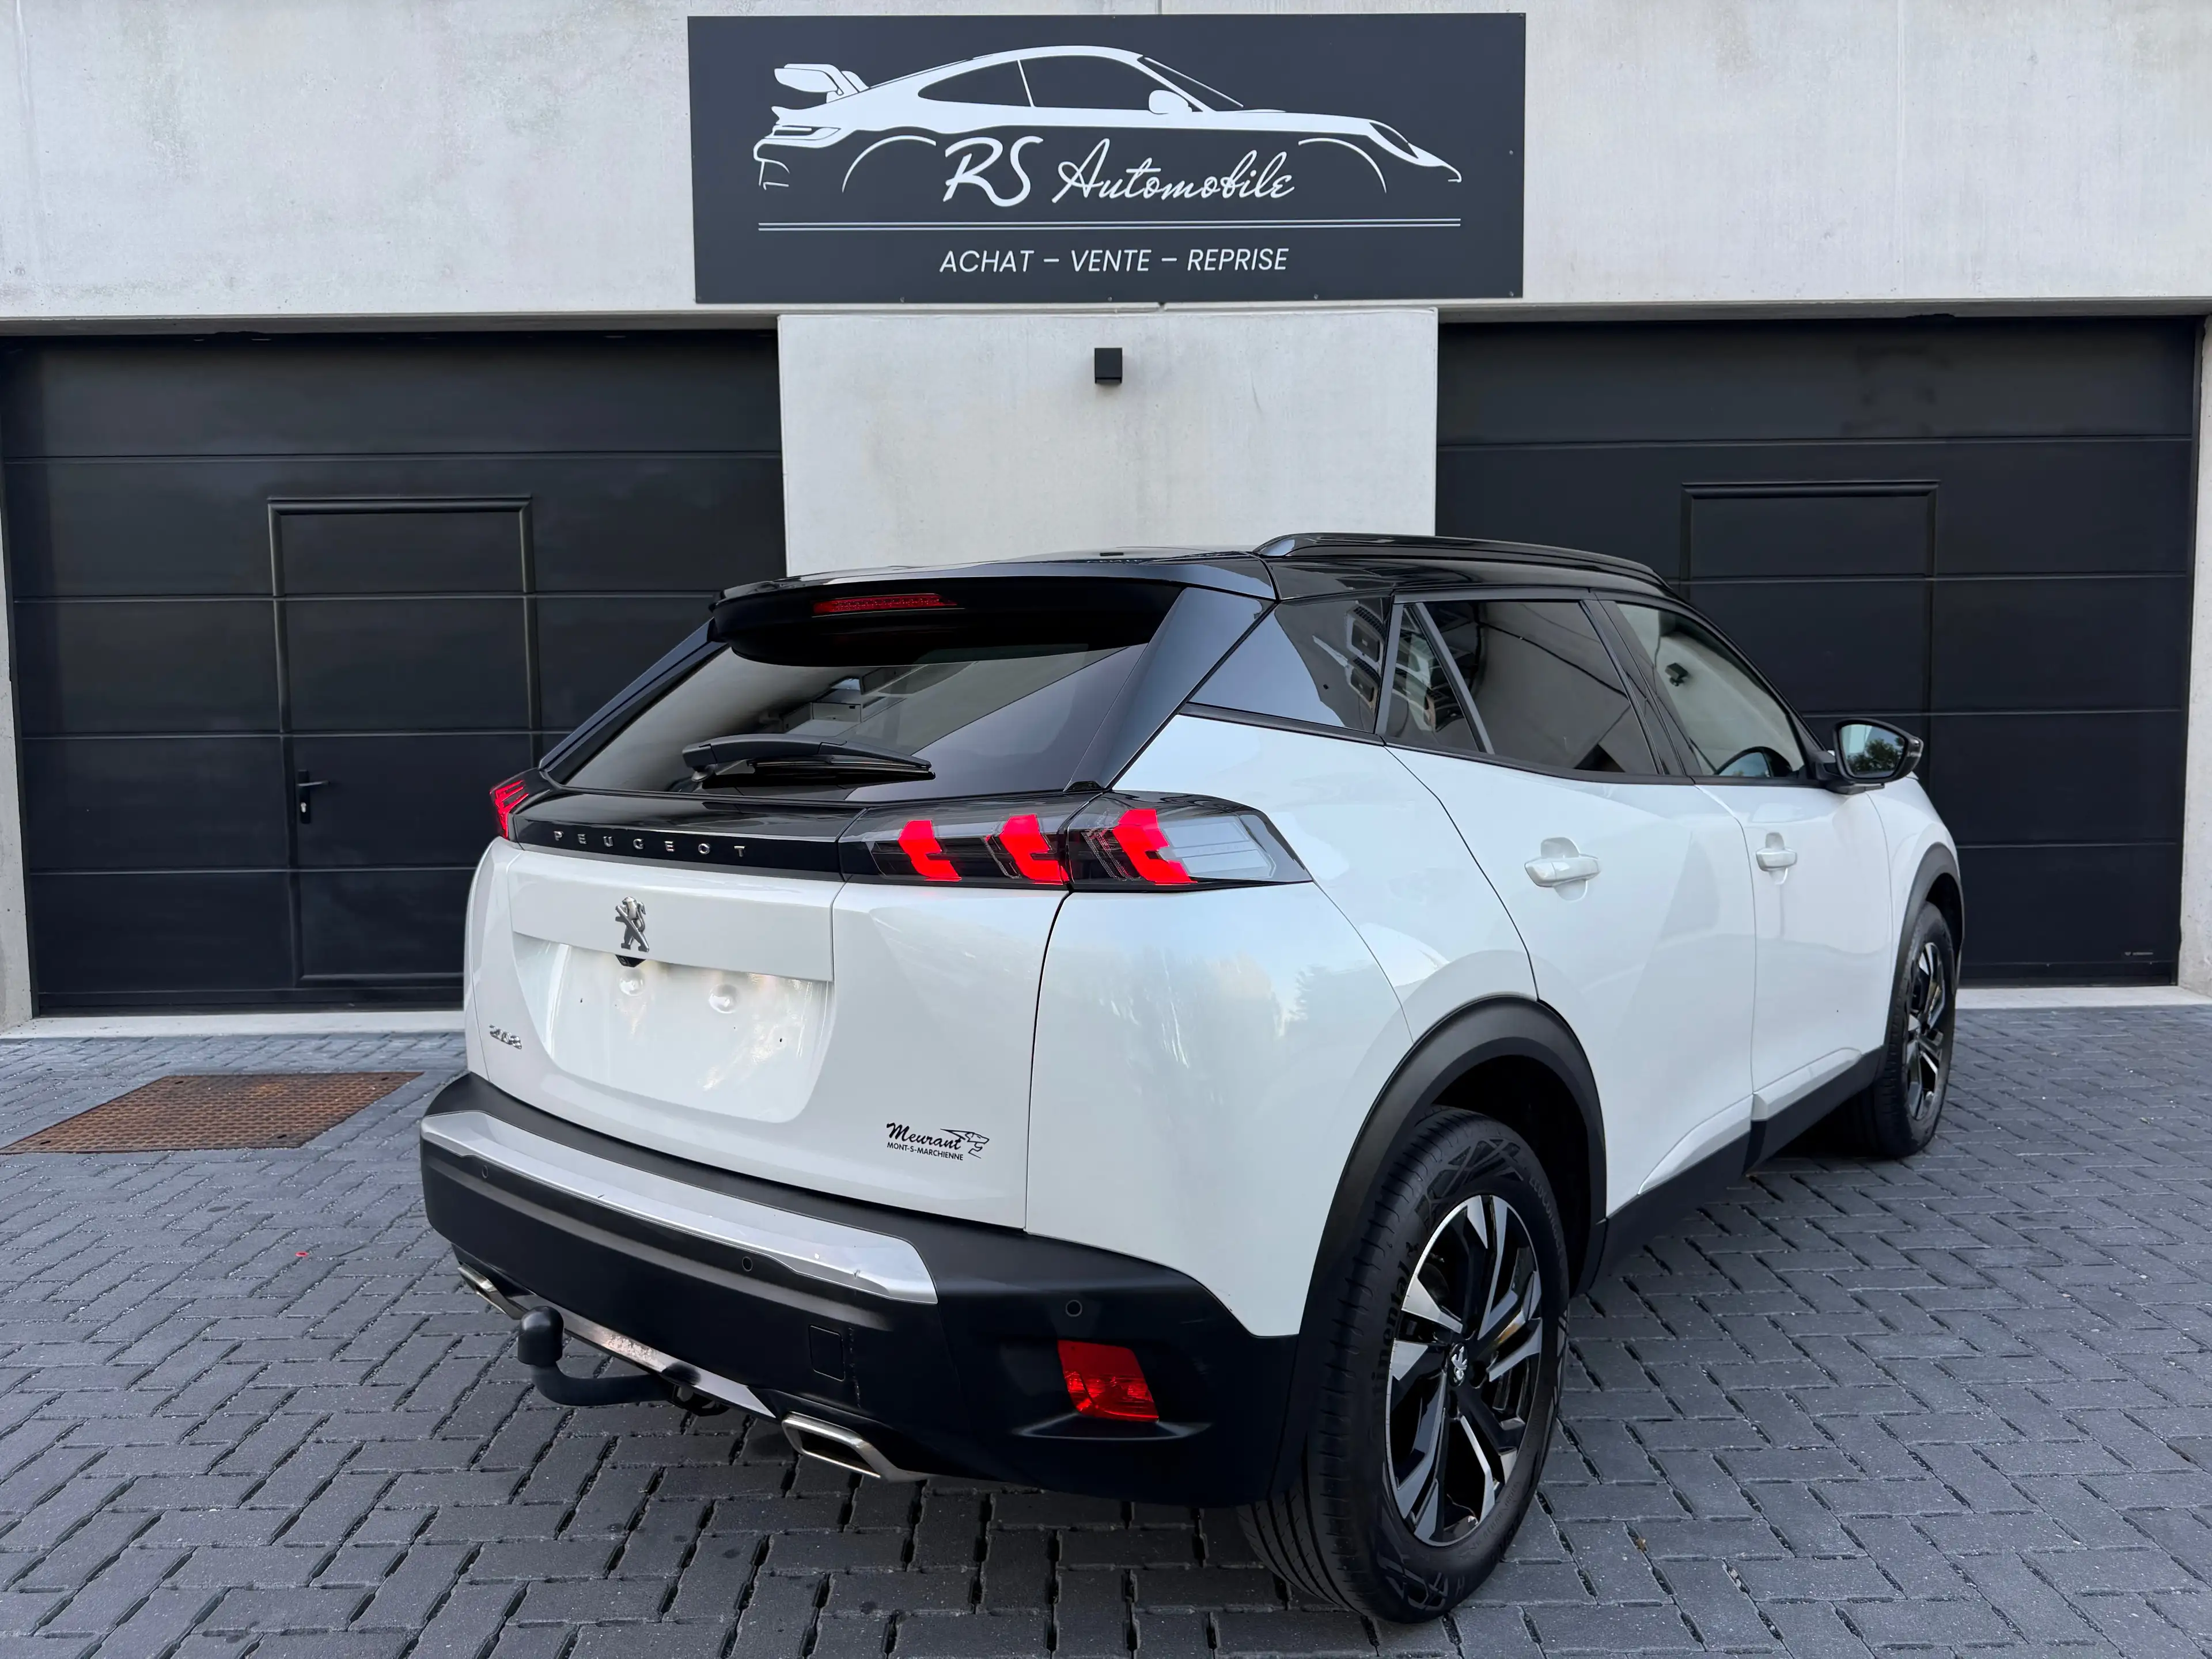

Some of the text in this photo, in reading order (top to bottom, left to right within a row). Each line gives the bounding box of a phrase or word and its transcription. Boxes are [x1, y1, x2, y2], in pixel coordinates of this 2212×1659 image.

[943, 135, 1295, 207] RS Automobile
[940, 249, 1035, 272] ACHAT
[1070, 249, 1152, 272] VENTE
[1187, 248, 1290, 271] REPRISE
[552, 831, 745, 857] PEUGEOT
[887, 1122, 963, 1150] Meurant
[887, 1141, 964, 1161] MONT-S-MARCHIENNE
